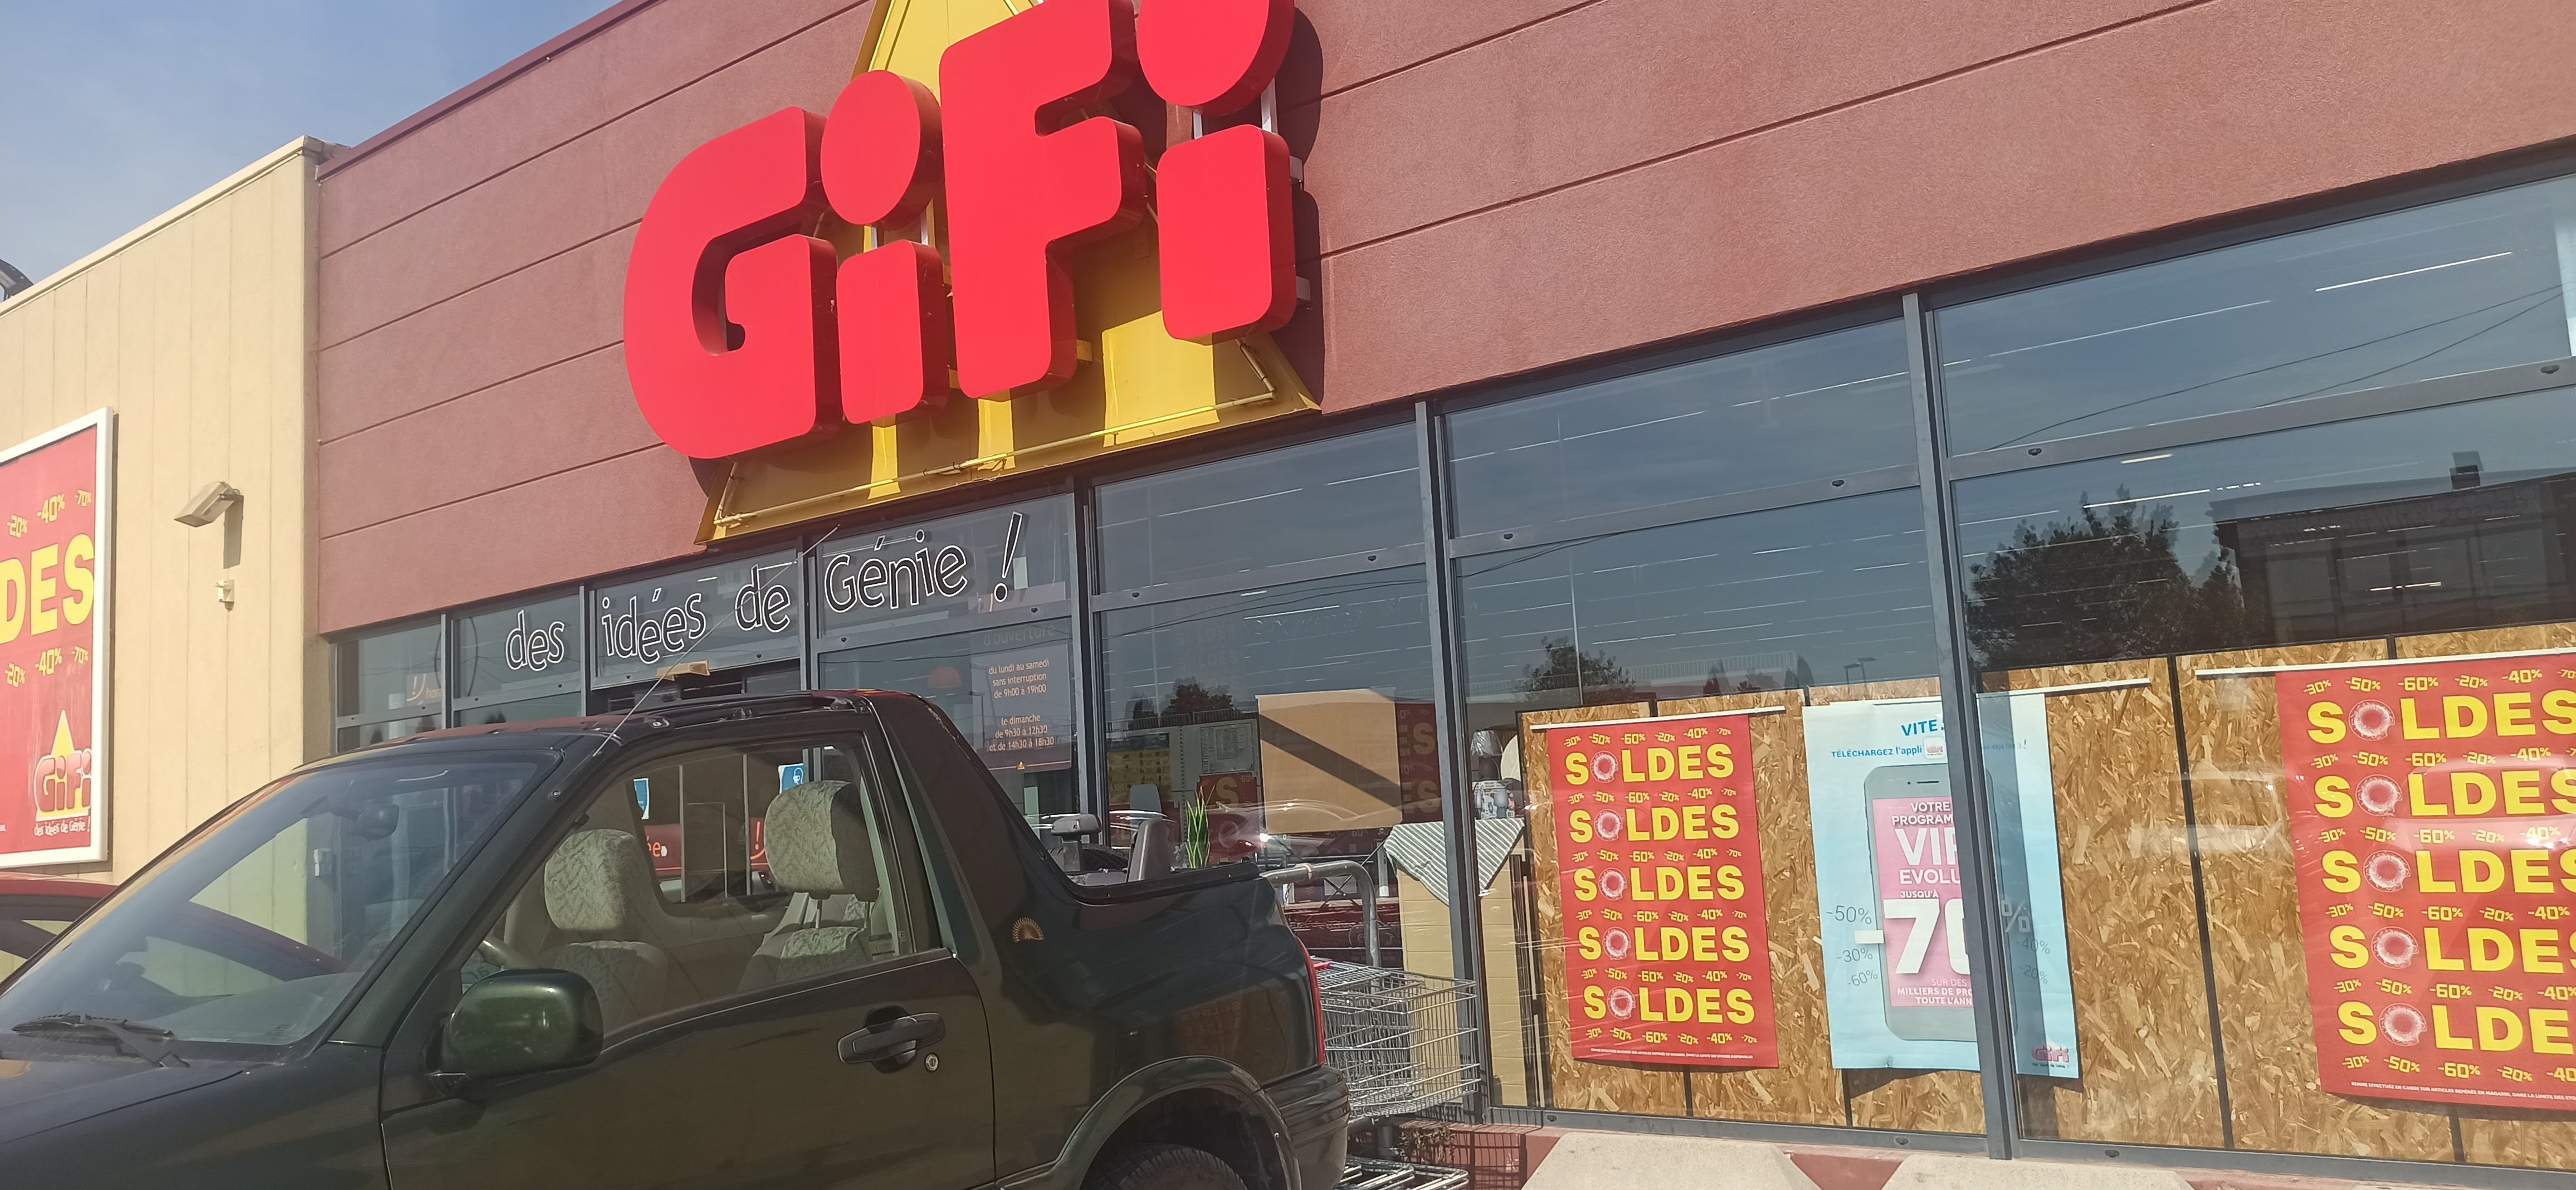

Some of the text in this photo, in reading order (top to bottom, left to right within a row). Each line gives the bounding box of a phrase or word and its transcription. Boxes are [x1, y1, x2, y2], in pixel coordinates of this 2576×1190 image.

[623, 0, 1297, 460] GiFi
[7, 490, 91, 537] -20% -40% -70%
[0, 534, 95, 644] DES
[505, 511, 1023, 671] des idées de Génie !
[5, 646, 88, 687] -20% -40% -70%
[989, 666, 997, 675] du
[998, 664, 1014, 673] lundi
[1026, 659, 1050, 670] samedi
[1008, 673, 1047, 684] interruption
[2304, 670, 2576, 695] -30% -50% -60% -20% -40% -70
[994, 690, 1002, 699] de
[1004, 687, 1019, 697] 9h00
[1027, 684, 1047, 694] 19h00
[1009, 714, 1041, 725] dimanche
[1901, 719, 1938, 736] VITE
[1005, 728, 1021, 738] 9h30
[1029, 725, 1047, 735] 12h30
[1564, 735, 1580, 747] -30%
[1589, 734, 1610, 744] -50%
[1621, 734, 1646, 744] -60%
[1655, 732, 1675, 742] -20%
[1684, 728, 1707, 739] -40%
[998, 742, 1006, 750] de
[1008, 739, 1027, 749] 14h30
[1035, 737, 1054, 747] 18h30
[1831, 748, 1894, 758] TÉLÉCHARGEZ
[1896, 745, 1922, 755] l'appli
[1565, 744, 1734, 784] SOLDES
[2311, 754, 2338, 768] -30%
[2353, 752, 2388, 766] -50%
[2406, 753, 2447, 767] -60%
[2463, 752, 2496, 765] -20%
[2510, 748, 2551, 761] -40%
[36, 751, 91, 812] GiFi
[1568, 793, 1584, 804] -30%
[1593, 792, 1614, 803] -50%
[1625, 792, 1650, 803] -60%
[1659, 792, 1679, 802] -20%
[1687, 788, 1712, 799] -40%
[1910, 802, 1951, 812] VOTRE
[1570, 804, 1739, 843] SOLDES
[1891, 814, 1954, 826] PROGRAM
[2318, 826, 2560, 843] -30% -50% -60% -20% -40%
[1572, 851, 1588, 862] -30%
[1597, 850, 1618, 861] -50%
[1629, 851, 1655, 862] -60%
[1664, 851, 1684, 861] -20%
[1693, 848, 1718, 859] -40%
[1574, 865, 1744, 901] SOLDES
[1899, 869, 1961, 885] EVOLU
[1900, 889, 1939, 898] JUSQU'À
[1576, 910, 1592, 920] -30%
[1601, 909, 1622, 920] -50%
[1633, 911, 1658, 922] -60%
[1668, 911, 1689, 922] -20%
[1697, 909, 1723, 920] -40%
[1826, 905, 1872, 924] -50%
[2326, 903, 2570, 921] -30% -50% -60% -20% -40%
[1579, 926, 1749, 962] SOLDES
[2016, 937, 2050, 954] -40%
[2330, 925, 2576, 975] SOLDE
[1837, 948, 1873, 963] -30%
[1582, 968, 1752, 983] -30% -50% -60% -20% -40% -70%
[1847, 970, 1878, 986] -60%
[1951, 978, 1967, 987] DES
[2018, 964, 2048, 984] -20%
[2334, 979, 2576, 1001] -30% -50% -60% -20% -40%
[1584, 986, 1755, 1025] SOLDES
[1915, 996, 1972, 1005] TOUTE L'ANN
[1586, 1028, 1602, 1038] -30%
[1610, 1028, 1632, 1040] -50%
[1642, 1032, 1667, 1043] -60%
[1677, 1033, 1698, 1045] -20%
[1707, 1033, 1732, 1043] -40%
[2343, 1056, 2576, 1081] -30% -50% -60% -20% -40
